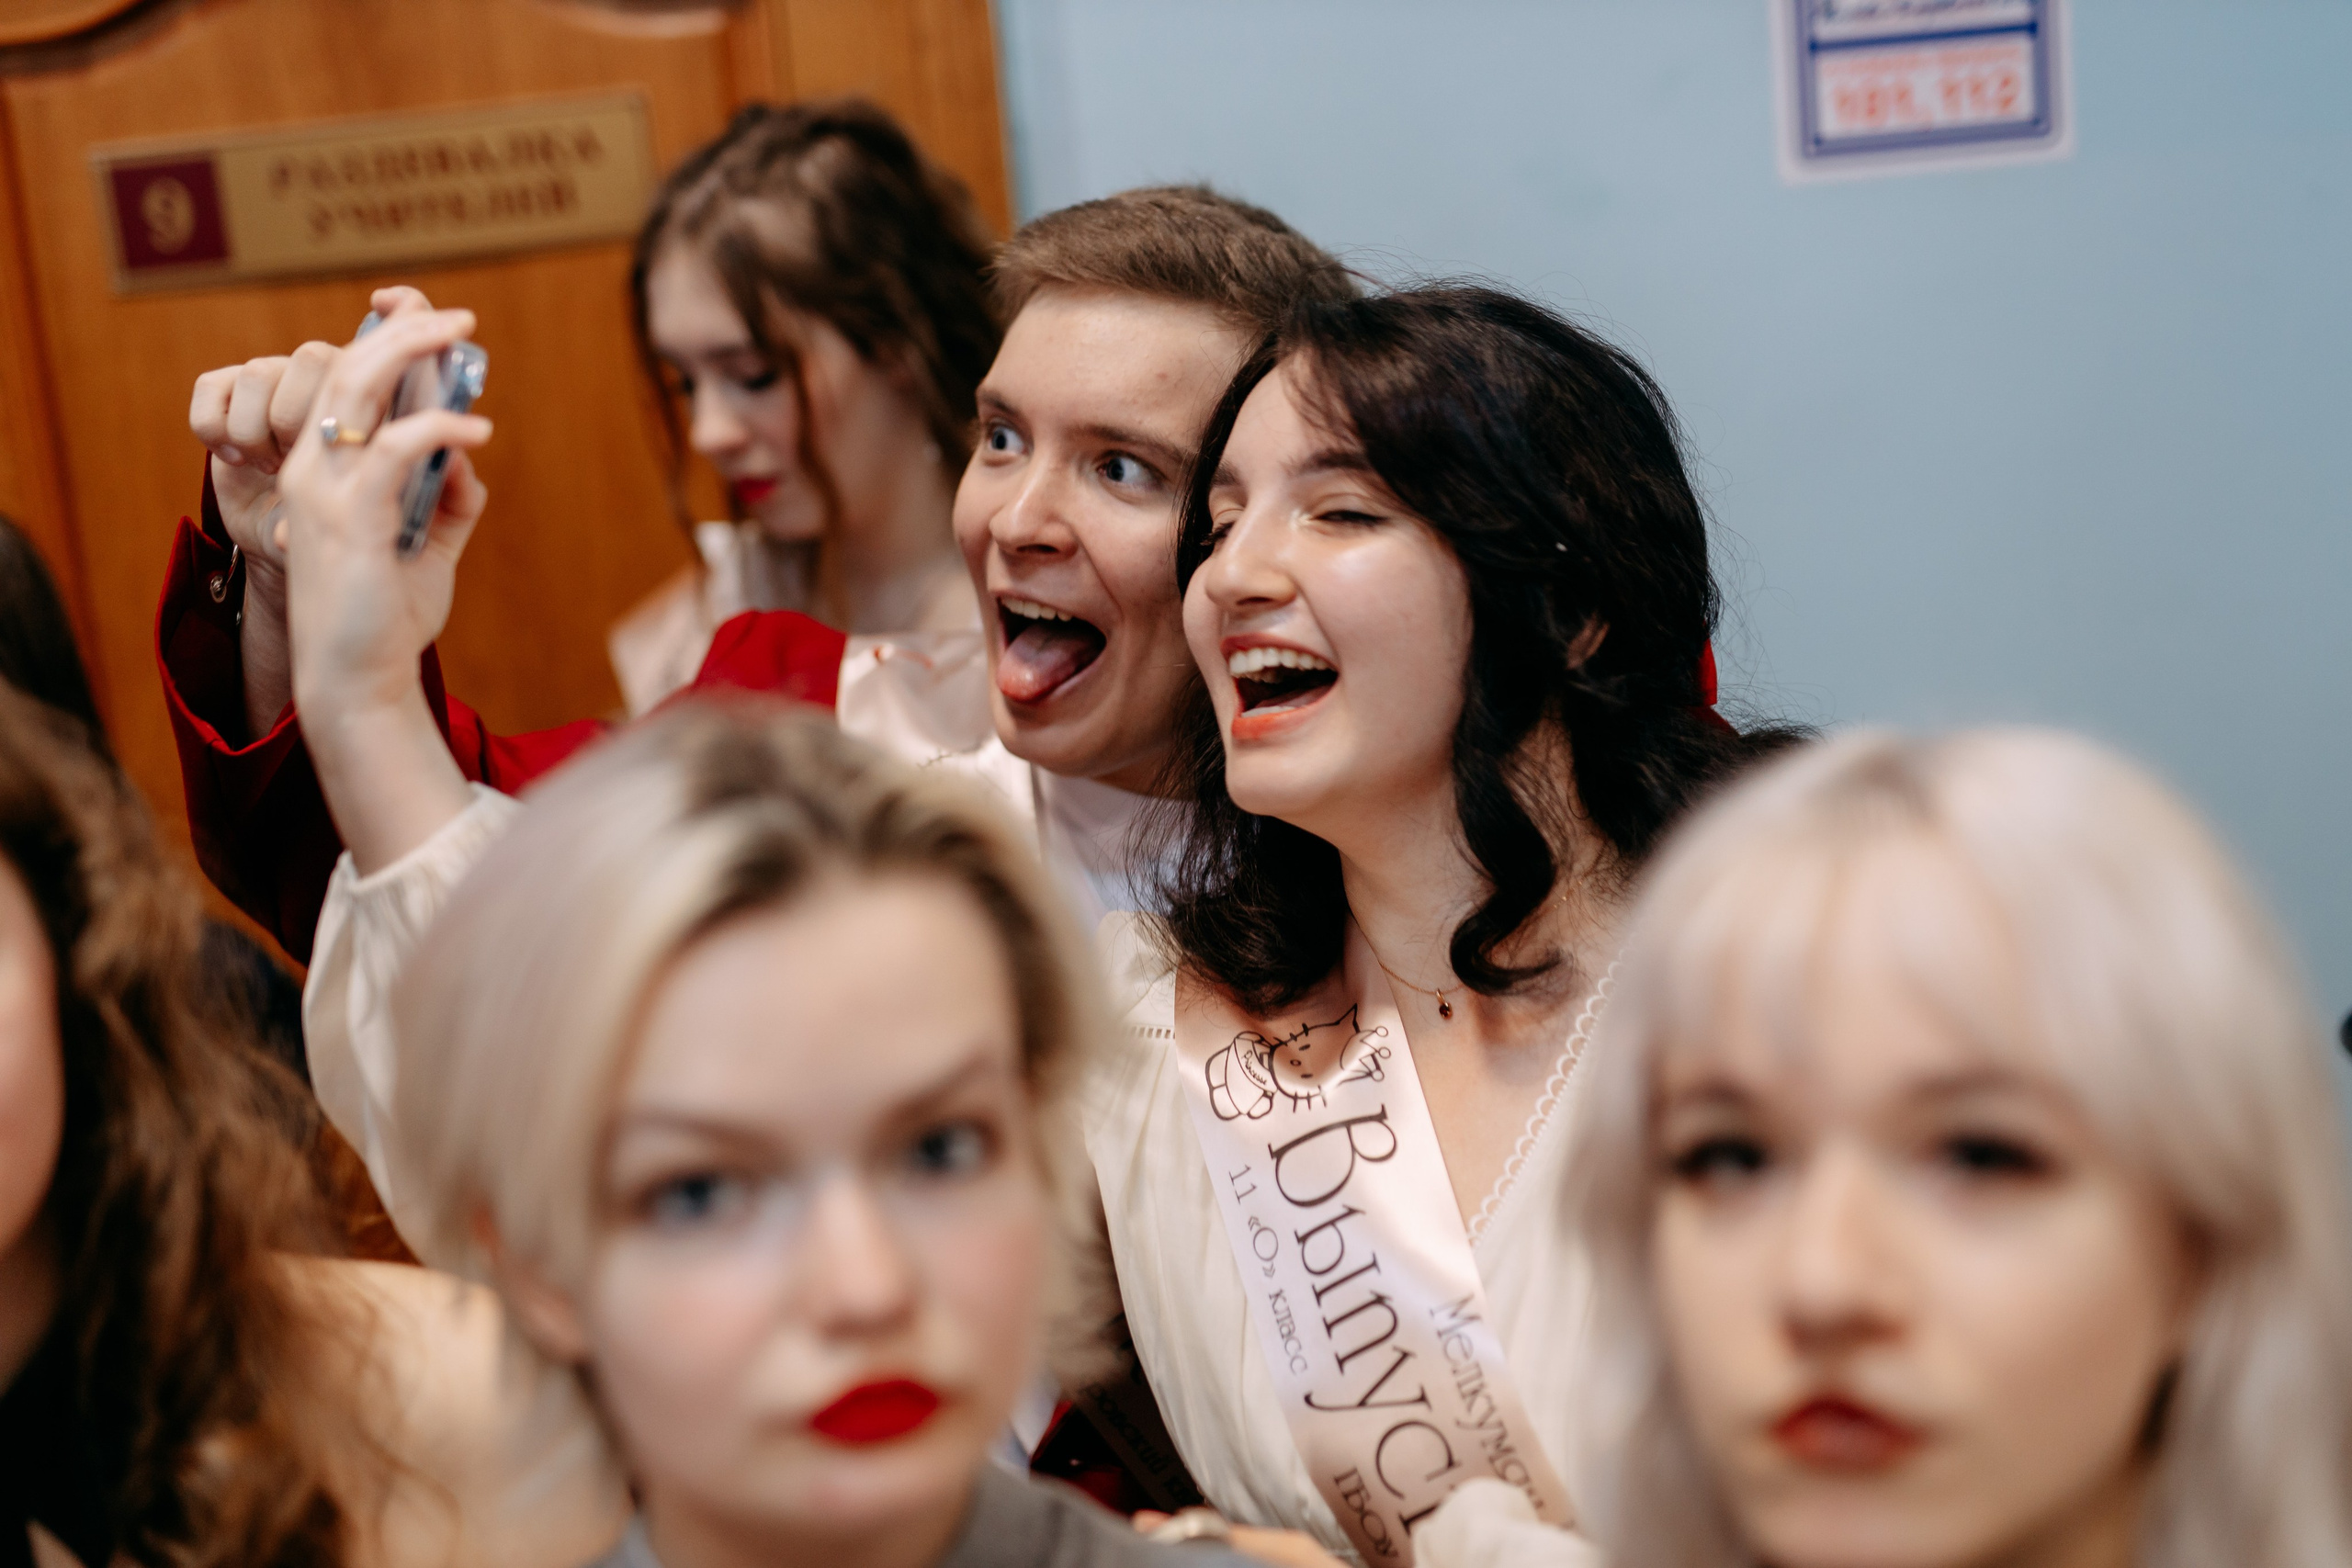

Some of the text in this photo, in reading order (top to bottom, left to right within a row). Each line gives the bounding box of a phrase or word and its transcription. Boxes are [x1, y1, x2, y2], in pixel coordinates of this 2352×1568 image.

[141, 176, 194, 255] 9
[1227, 1163, 1253, 1206] 11
[1268, 1288, 1308, 1375] класс
[1430, 1293, 1544, 1508] Мелкумо
